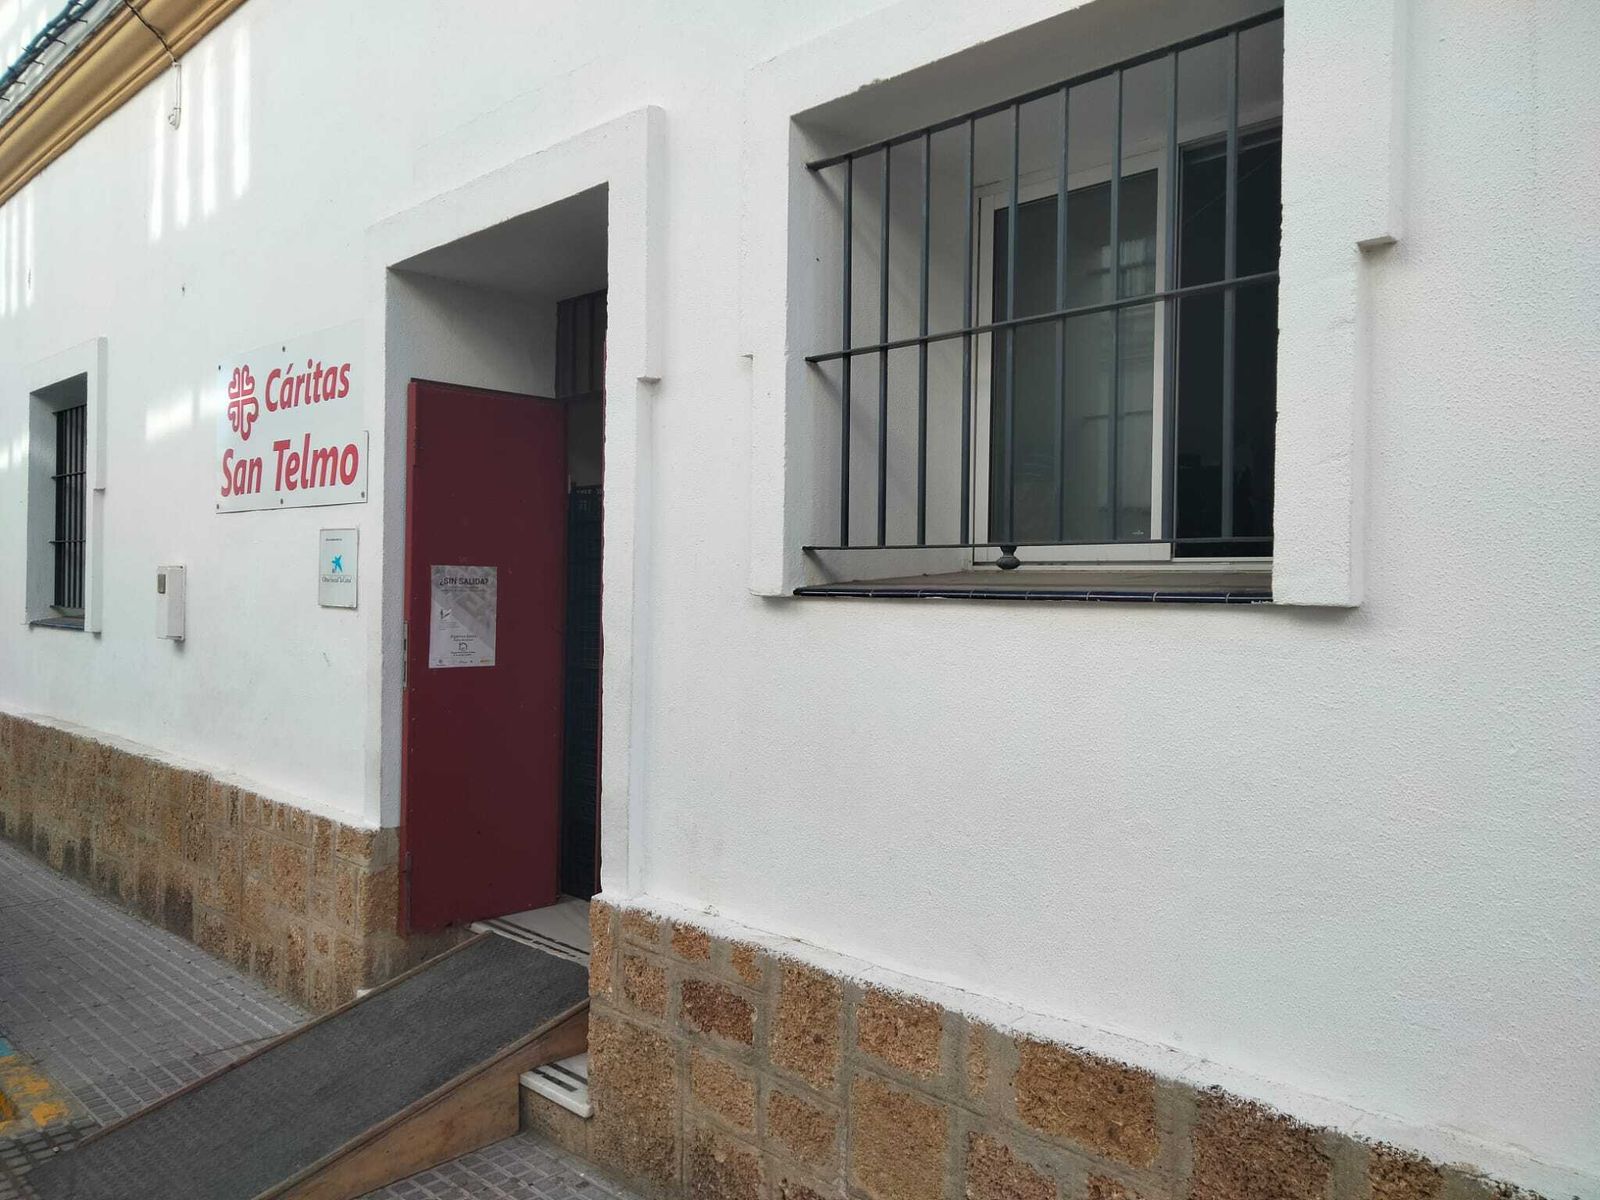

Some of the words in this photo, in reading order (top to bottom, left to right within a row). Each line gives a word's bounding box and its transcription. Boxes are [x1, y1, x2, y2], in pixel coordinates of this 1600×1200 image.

[265, 358, 351, 412] Cáritas
[221, 448, 263, 497] San
[273, 433, 359, 491] Telmo
[439, 577, 457, 586] ¿SIN
[458, 577, 489, 586] SALIDA?
